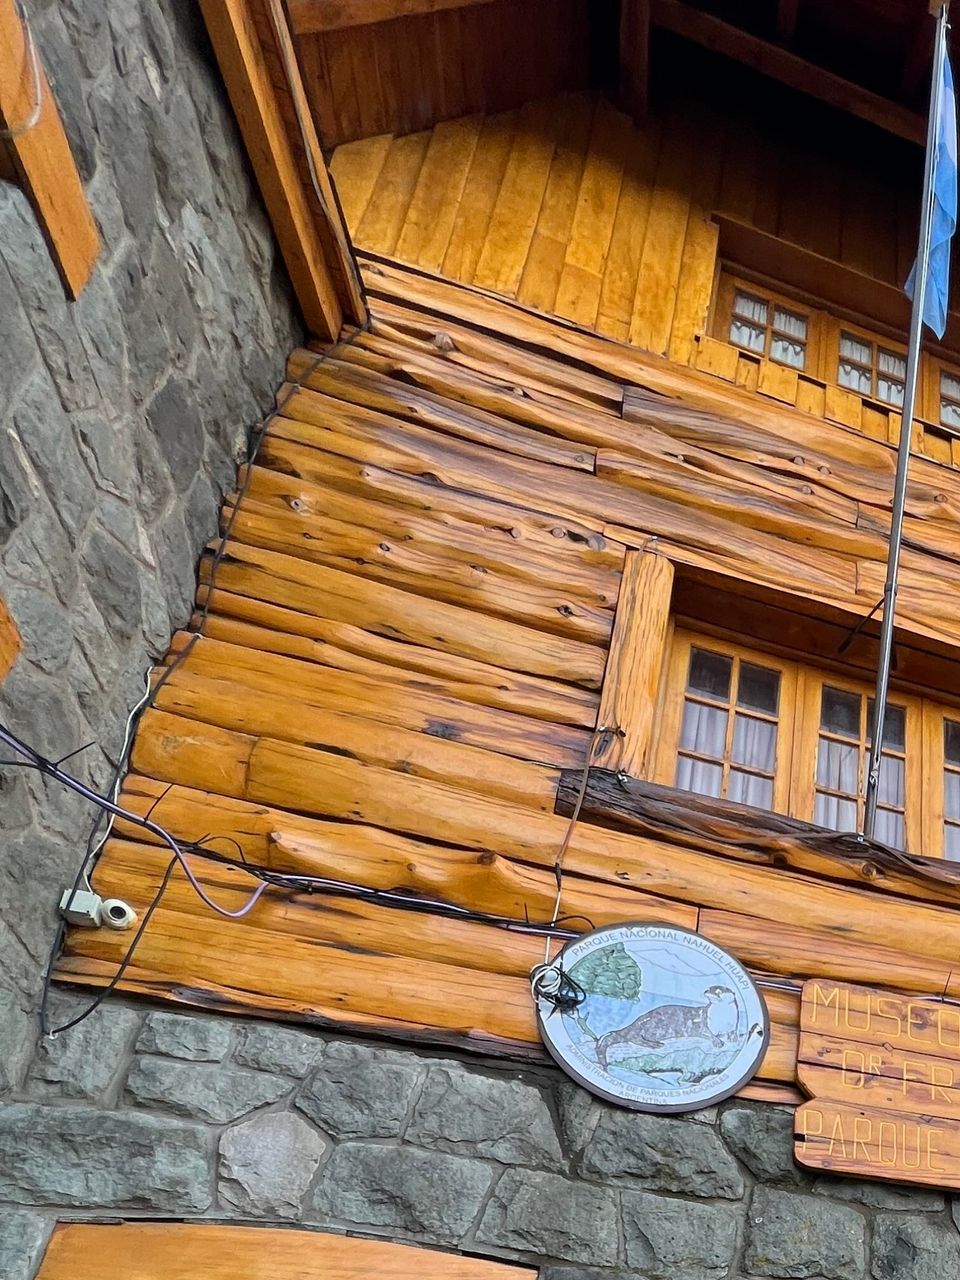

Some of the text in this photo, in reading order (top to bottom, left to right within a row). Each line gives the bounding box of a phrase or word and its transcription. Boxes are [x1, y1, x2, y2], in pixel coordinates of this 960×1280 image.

[572, 929, 750, 990] PARQUE NACIONAL NAHUEL HUAPI
[618, 1090, 668, 1104] ARGENTINA
[625, 1084, 638, 1092] DE
[640, 1088, 681, 1098] PARQUES
[682, 1073, 729, 1095] NACIONALES
[803, 1110, 945, 1172] PARQUE
